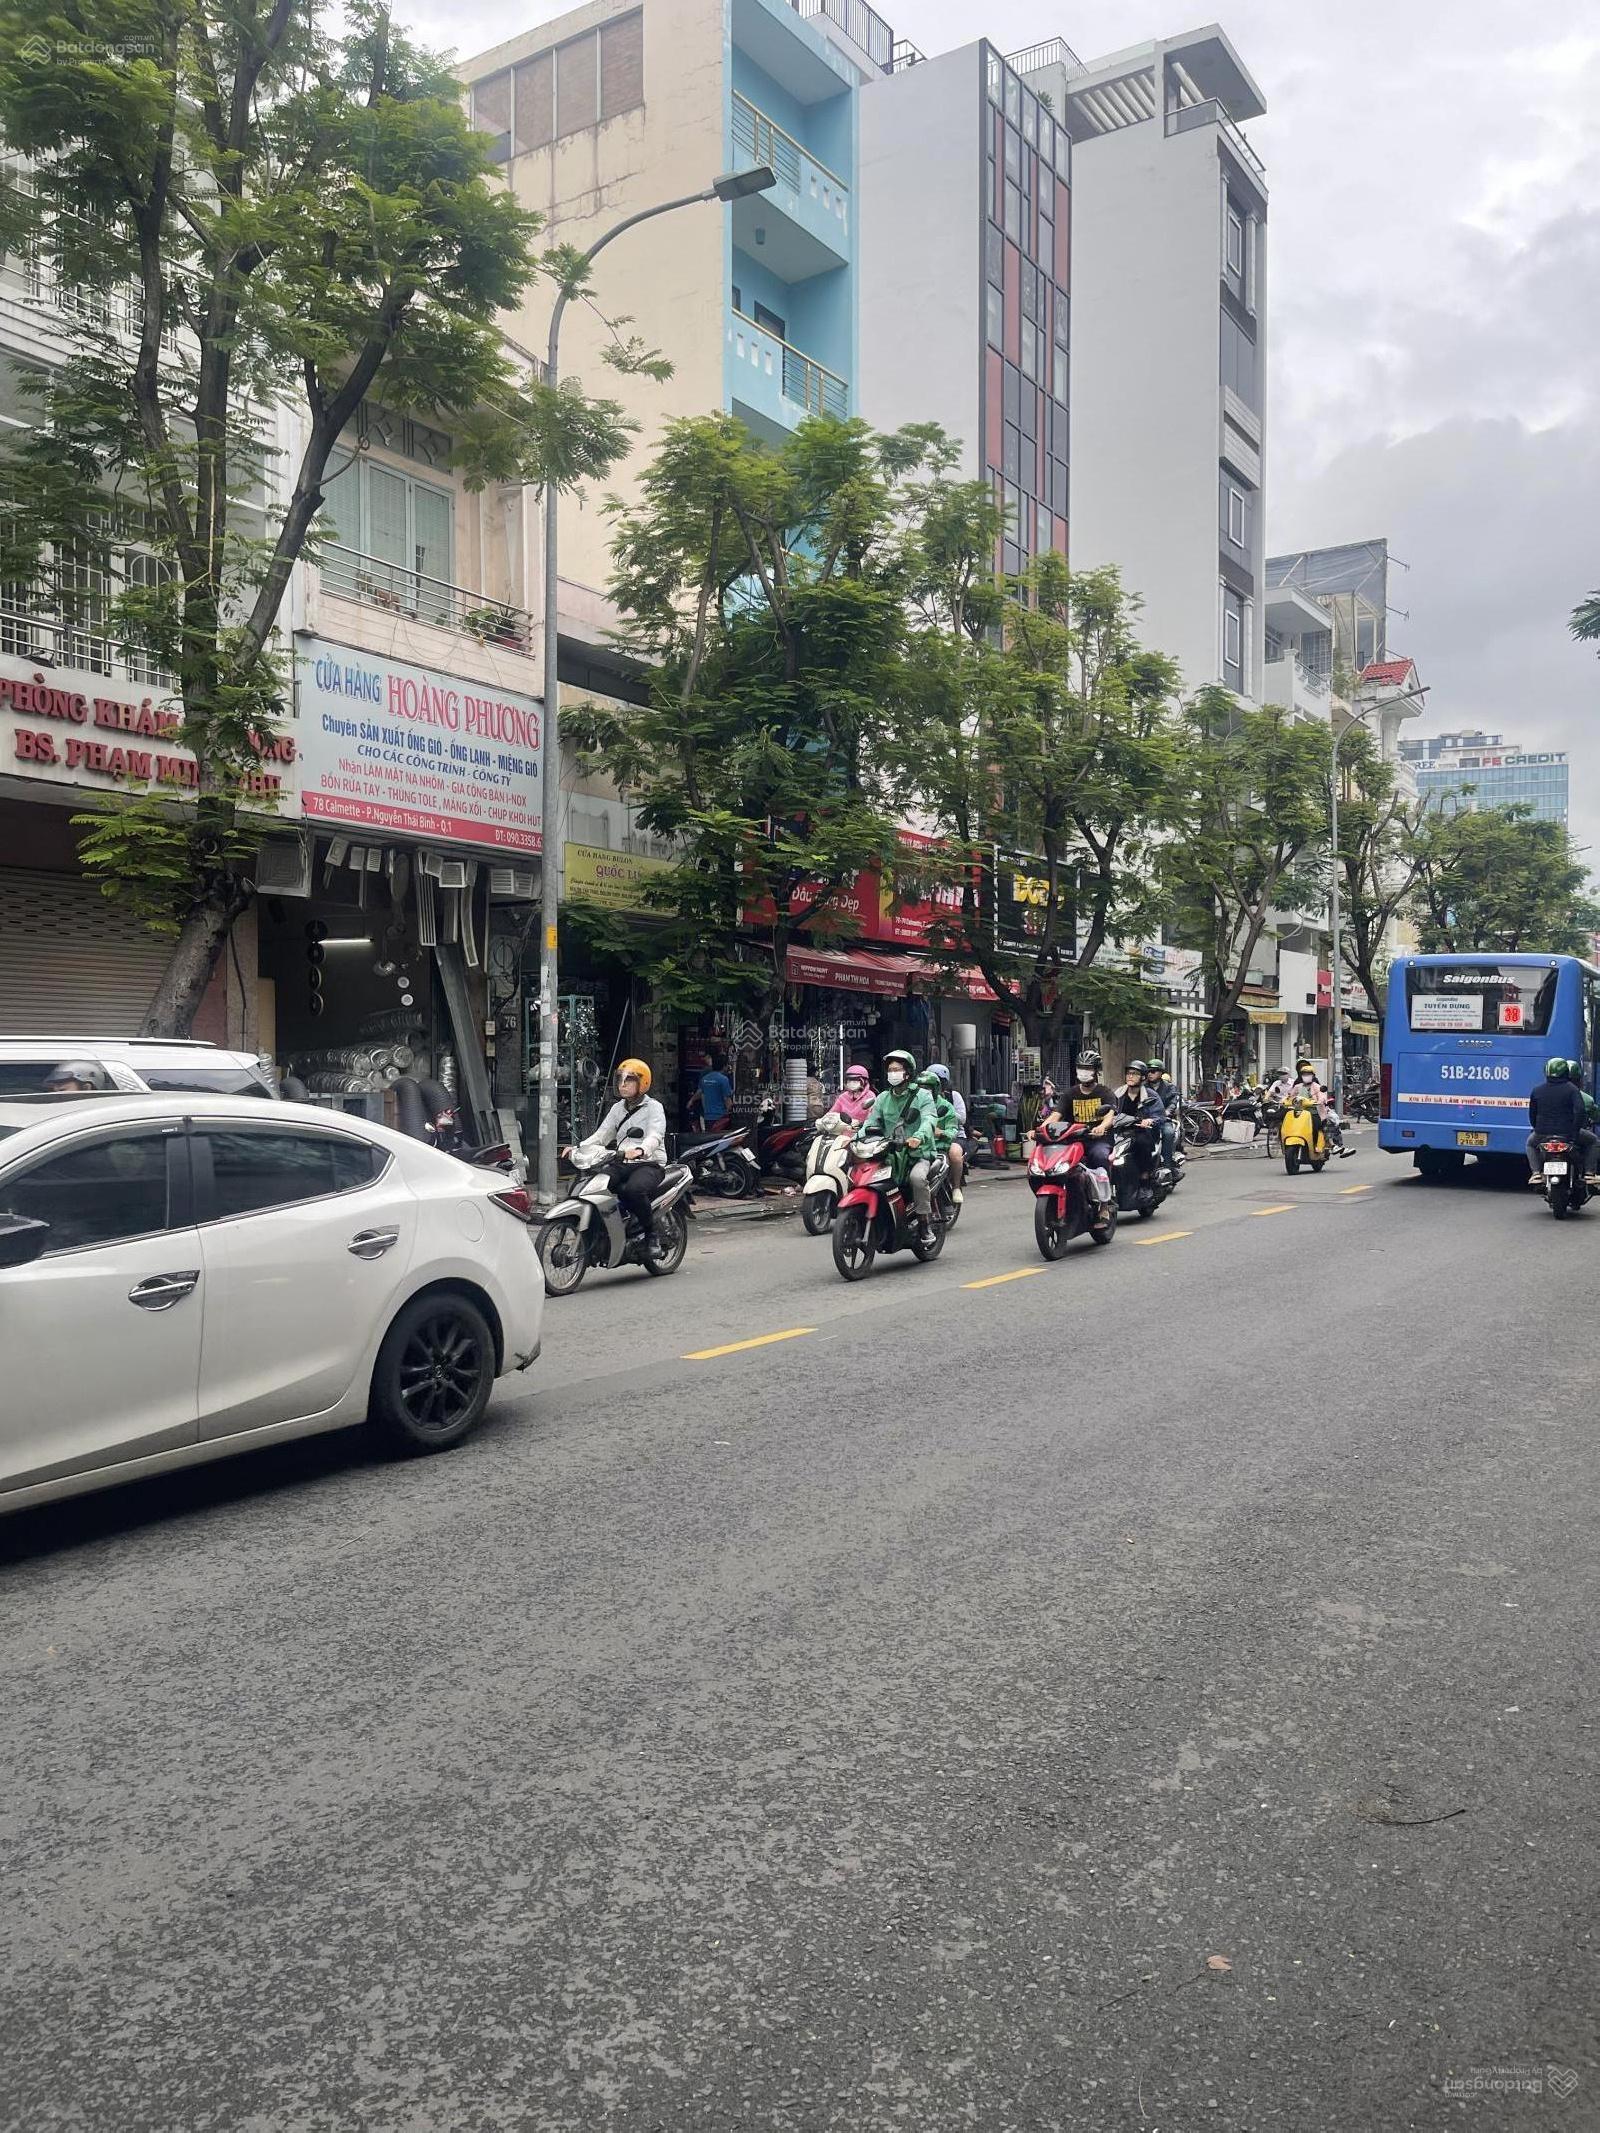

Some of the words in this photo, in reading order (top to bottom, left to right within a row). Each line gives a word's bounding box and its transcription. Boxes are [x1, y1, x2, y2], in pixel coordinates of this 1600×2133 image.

[0, 672, 89, 724] PHÒNG
[94, 698, 181, 740] KHÁM
[315, 652, 342, 694] CỬA
[344, 661, 382, 703] HÀNG
[387, 673, 460, 730] HOÀNG
[463, 693, 540, 750] PHƯƠNG
[14, 728, 61, 764] BS.
[65, 737, 153, 783] PHẠM
[322, 713, 357, 738] Chuyên
[360, 718, 380, 743] SẢN
[382, 724, 404, 748] XUẤT
[407, 727, 425, 753] ỐNG
[428, 735, 442, 756] GIÓ
[450, 738, 468, 762] ỐNG
[470, 748, 491, 768] LẠNH
[526, 757, 538, 778] GIÓ
[1482, 756, 1501, 767] FE
[1504, 752, 1567, 766] CREDIT
[338, 758, 362, 775] Nhận
[452, 782, 465, 795] GIA
[358, 744, 381, 759] CHO
[383, 748, 404, 764] CÁC
[406, 754, 435, 771] CÔNG
[438, 760, 465, 777] TRÌNH
[472, 767, 499, 784] CÔNG
[364, 781, 381, 798] TAY
[313, 797, 324, 811] 78
[325, 798, 361, 818] Calmette
[404, 812, 418, 828] Thái
[506, 831, 542, 848] 090.3358.6
[1442, 973, 1516, 984] SaigonBus
[500, 1015, 516, 1029] 76
[1440, 1064, 1510, 1081] 51B-216.08
